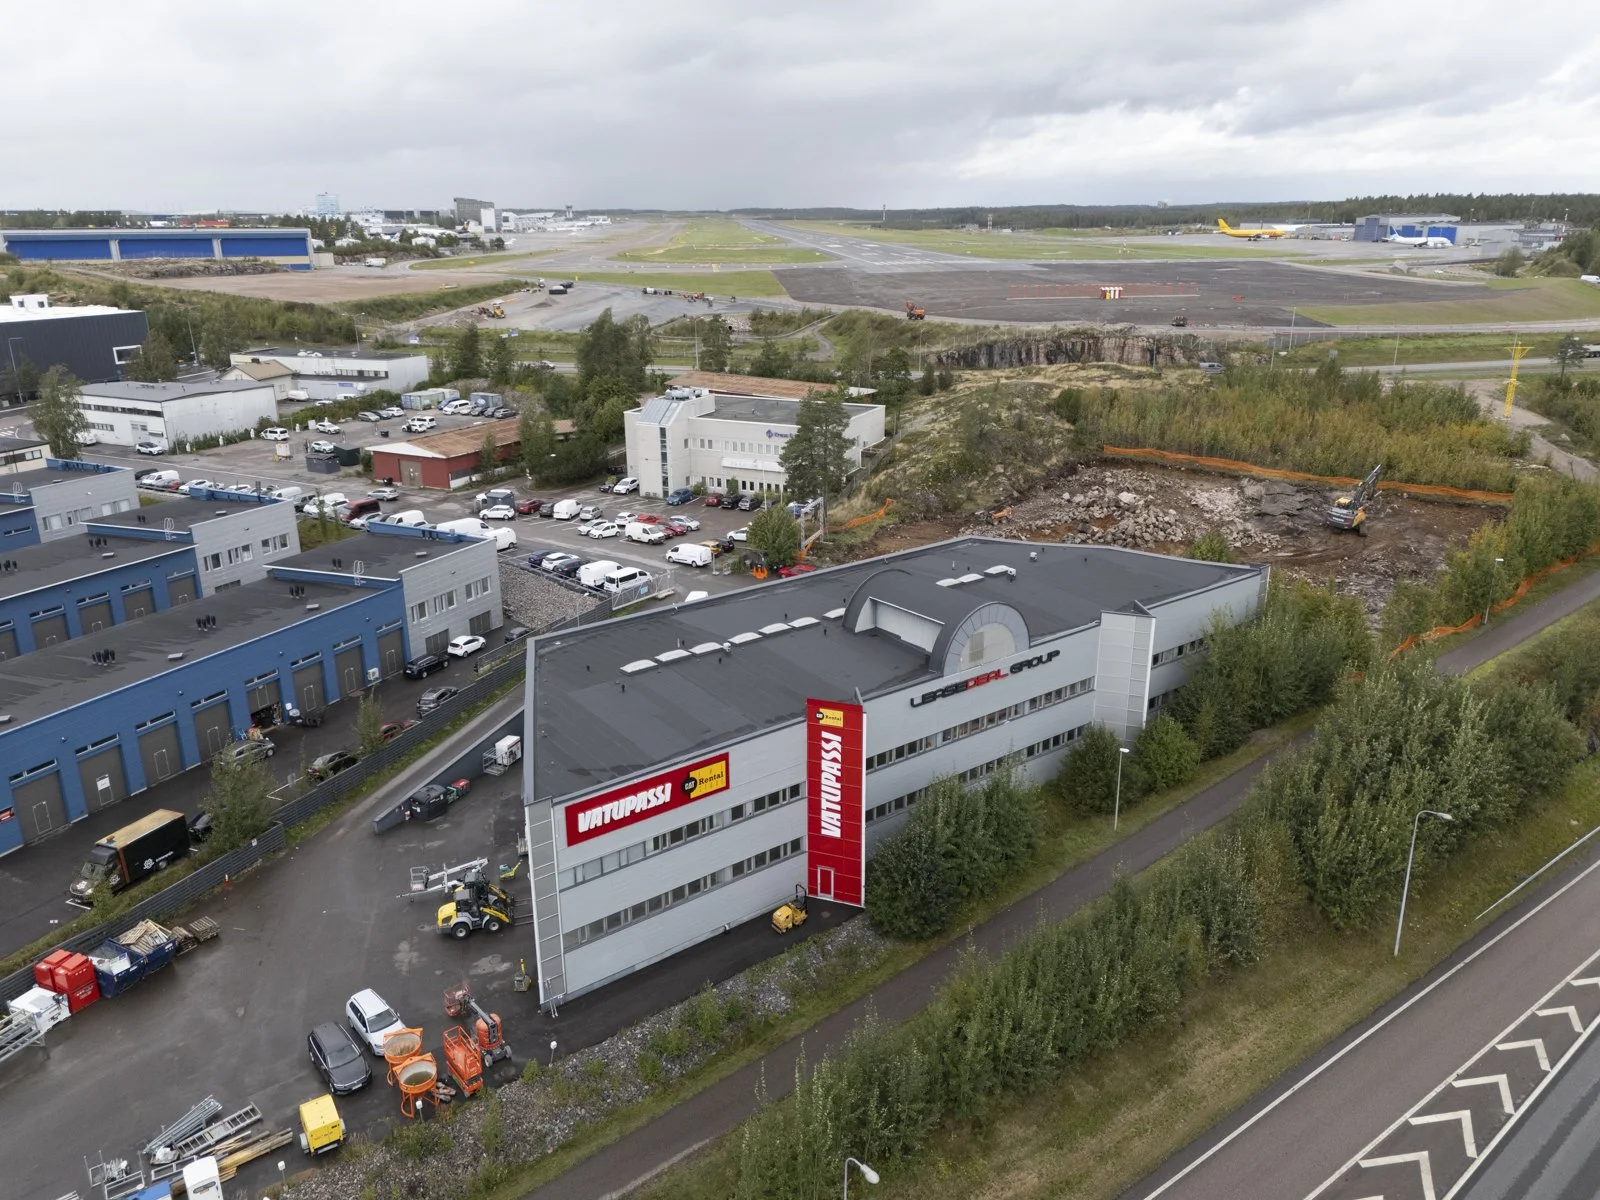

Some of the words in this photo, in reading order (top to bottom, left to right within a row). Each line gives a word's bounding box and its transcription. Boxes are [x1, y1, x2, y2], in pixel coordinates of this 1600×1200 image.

[1010, 650, 1060, 674] GROUP
[684, 781, 695, 790] CAT
[699, 771, 724, 785] Rental
[821, 730, 842, 838] VATUPASSI
[578, 783, 672, 833] VATUPASSI
